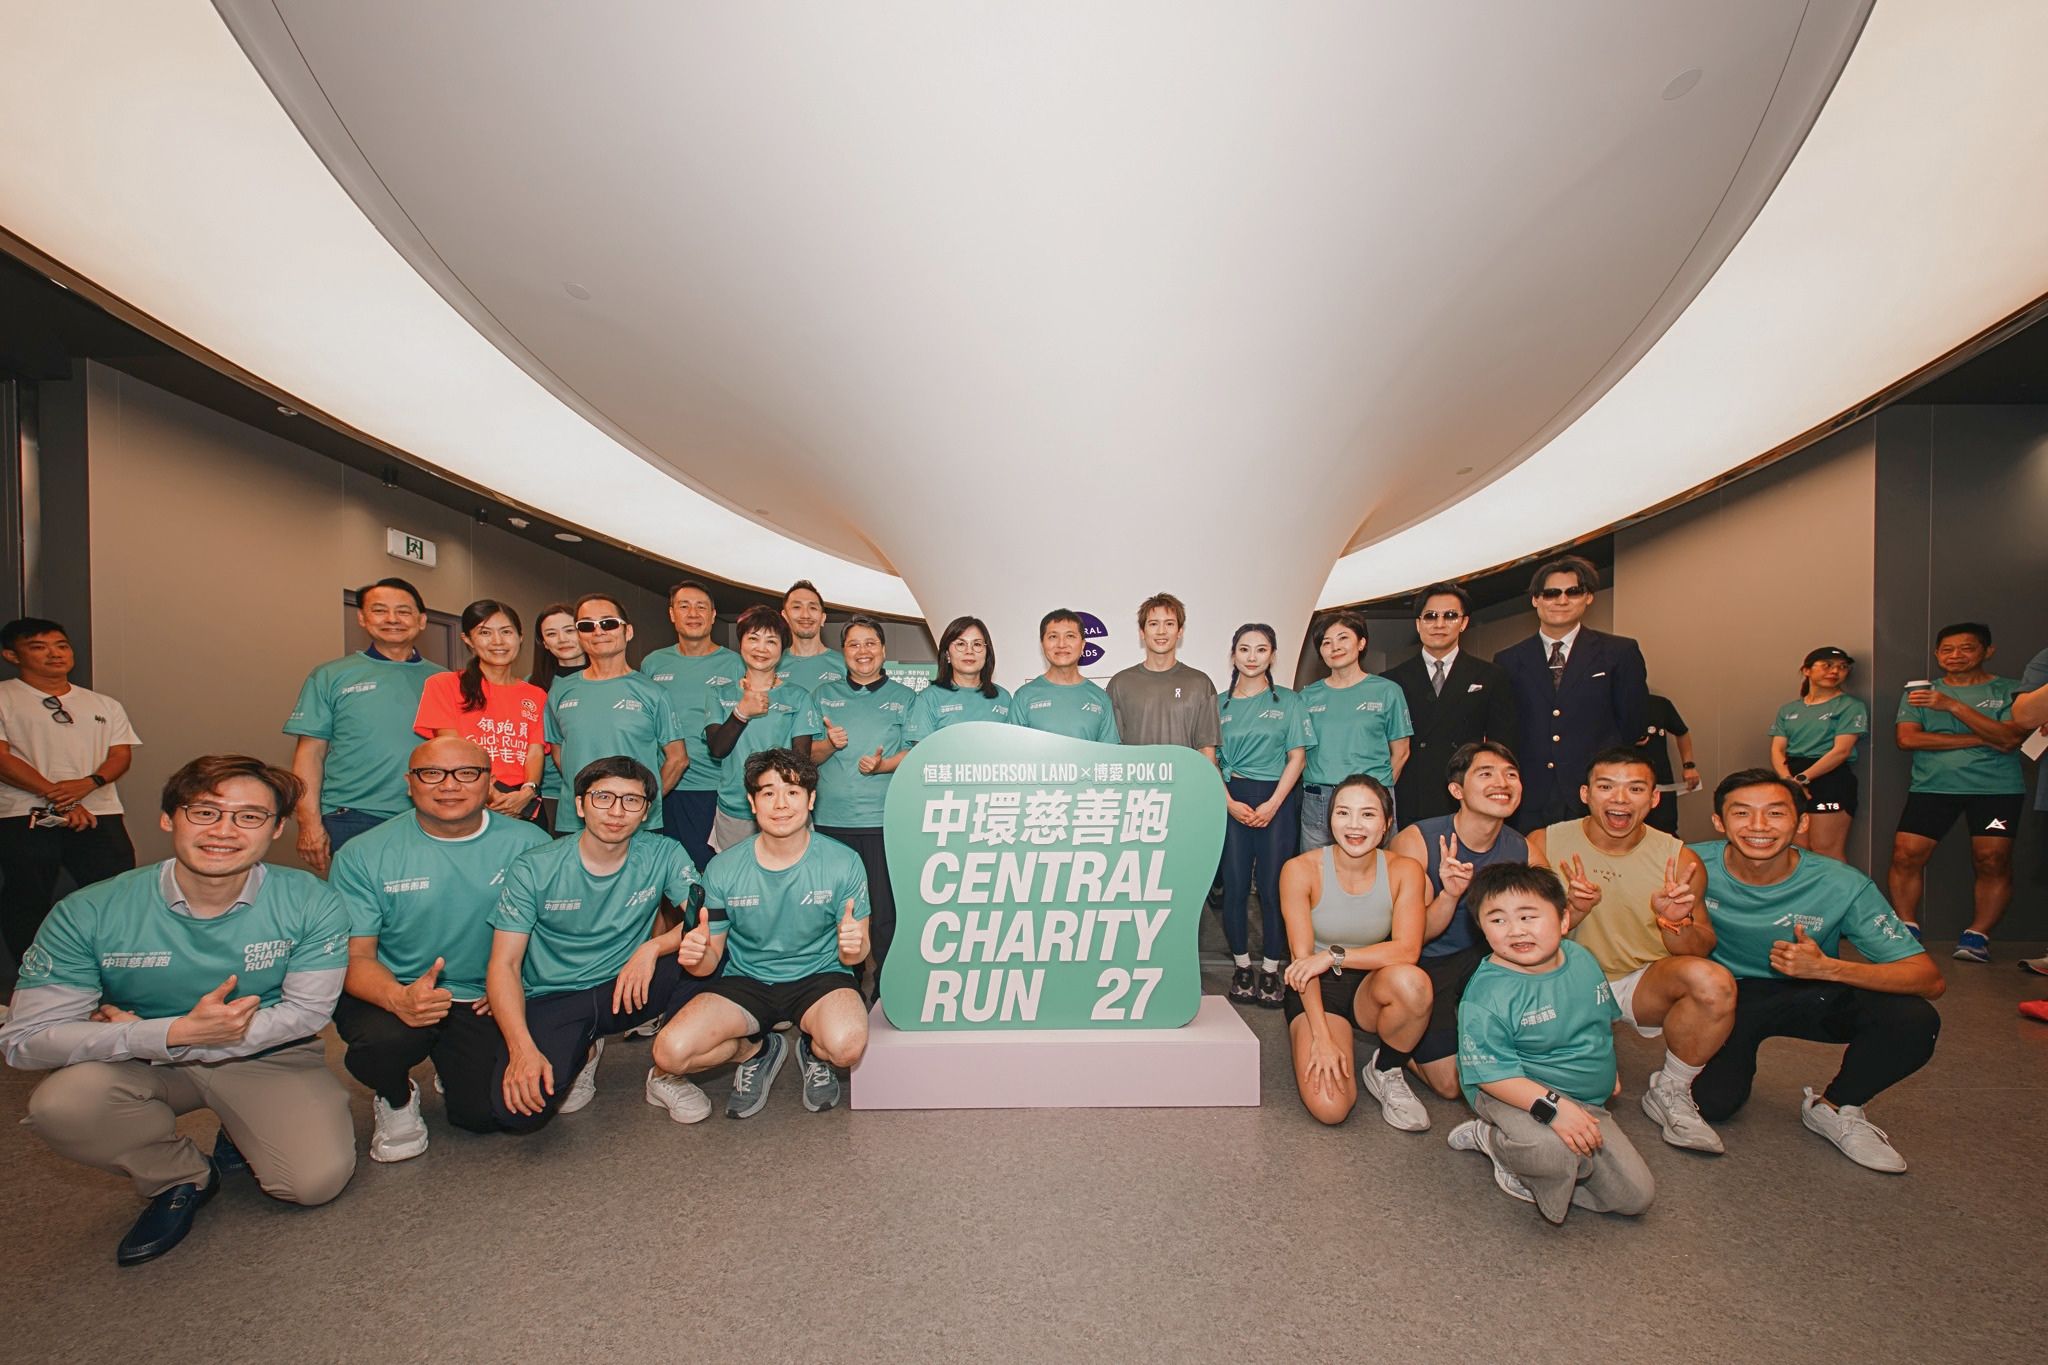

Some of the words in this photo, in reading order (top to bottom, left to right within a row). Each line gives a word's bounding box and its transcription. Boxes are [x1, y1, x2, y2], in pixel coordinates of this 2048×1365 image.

[465, 732, 500, 746] uid
[923, 763, 953, 783] 恒基
[955, 763, 1038, 782] HENDERSON
[1041, 763, 1078, 782] LAND
[1094, 763, 1124, 782] 博愛
[1127, 763, 1156, 781] POK
[1158, 762, 1174, 781] OI
[921, 788, 1172, 847] 中環慈善跑
[919, 850, 1173, 905] CENTRAL
[919, 909, 1172, 964] CHARITY
[245, 959, 275, 972] RUN
[920, 968, 1046, 1023] RUN
[1090, 967, 1164, 1021] 27
